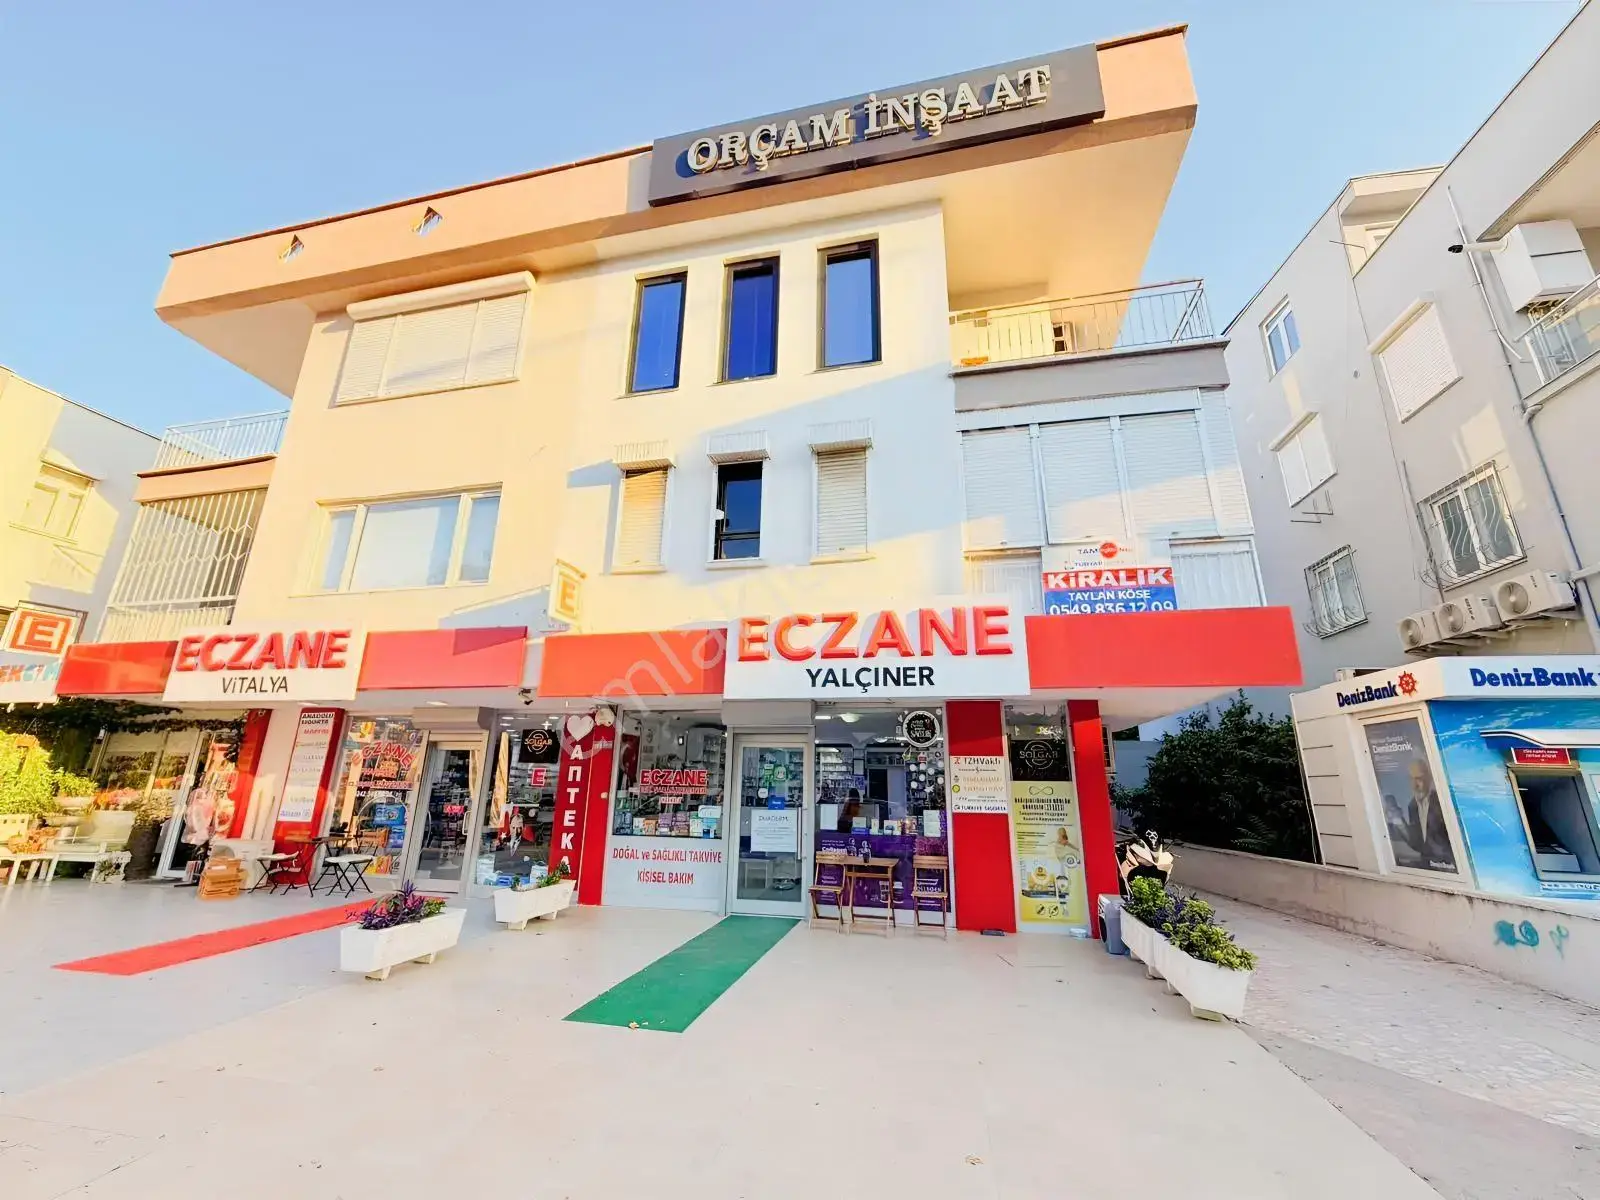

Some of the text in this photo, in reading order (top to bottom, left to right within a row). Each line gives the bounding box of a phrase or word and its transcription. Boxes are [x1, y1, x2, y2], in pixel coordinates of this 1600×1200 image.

[686, 64, 1052, 174] ORÇAM İNŞAAT
[1068, 588, 1151, 601] TAYLAN KÖSE
[737, 605, 1014, 662] ECZANE
[175, 629, 352, 672] ECZANE
[805, 666, 935, 693] YALÇINER
[1469, 667, 1597, 687] DenizBank
[1336, 680, 1399, 708] DenizBank
[640, 769, 707, 786] ECZANE
[612, 845, 639, 860] DOĞAL
[641, 851, 650, 861] ve
